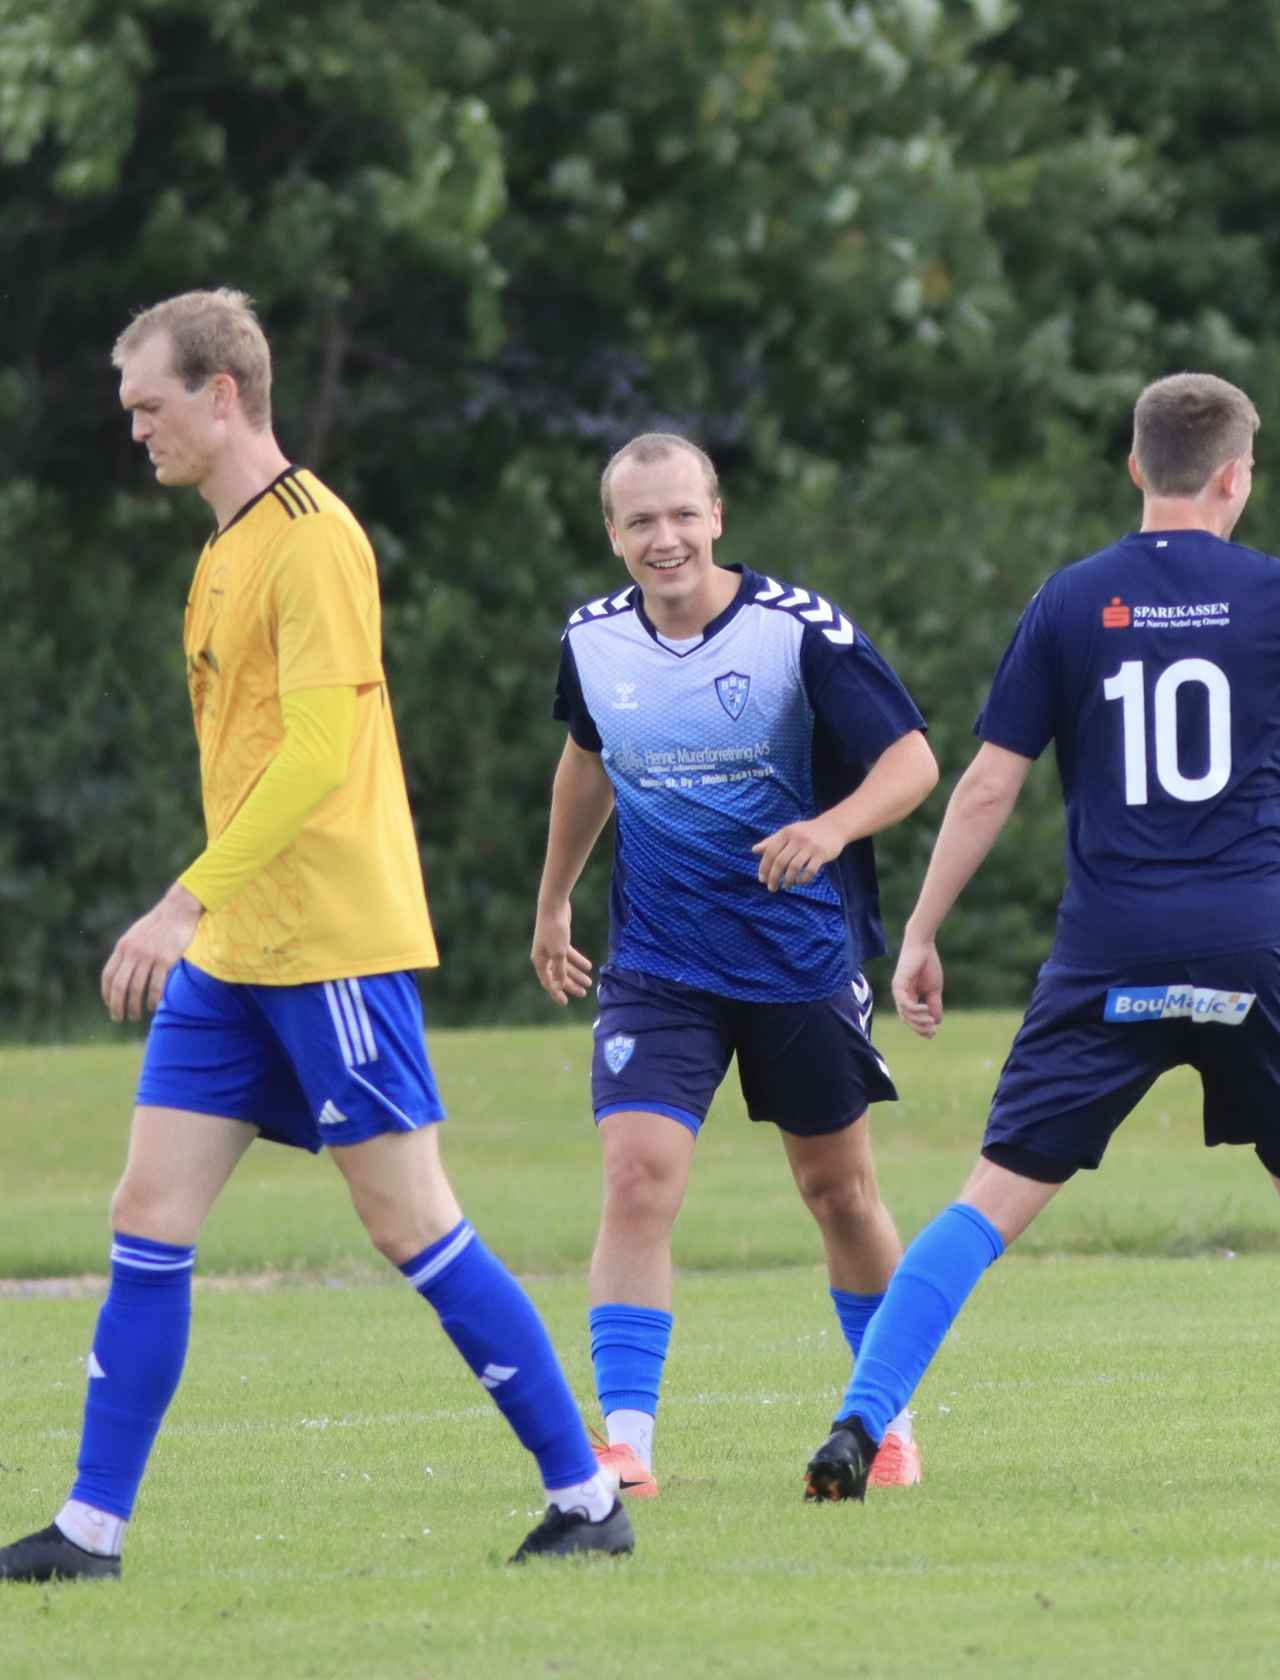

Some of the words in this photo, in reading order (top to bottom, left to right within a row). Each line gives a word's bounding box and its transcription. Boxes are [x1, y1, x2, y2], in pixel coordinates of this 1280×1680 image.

[1133, 602, 1230, 618] SPAREKASSEN
[1133, 619, 1146, 628] for
[1103, 657, 1232, 806] 10
[1115, 993, 1227, 1015] BouMatic
